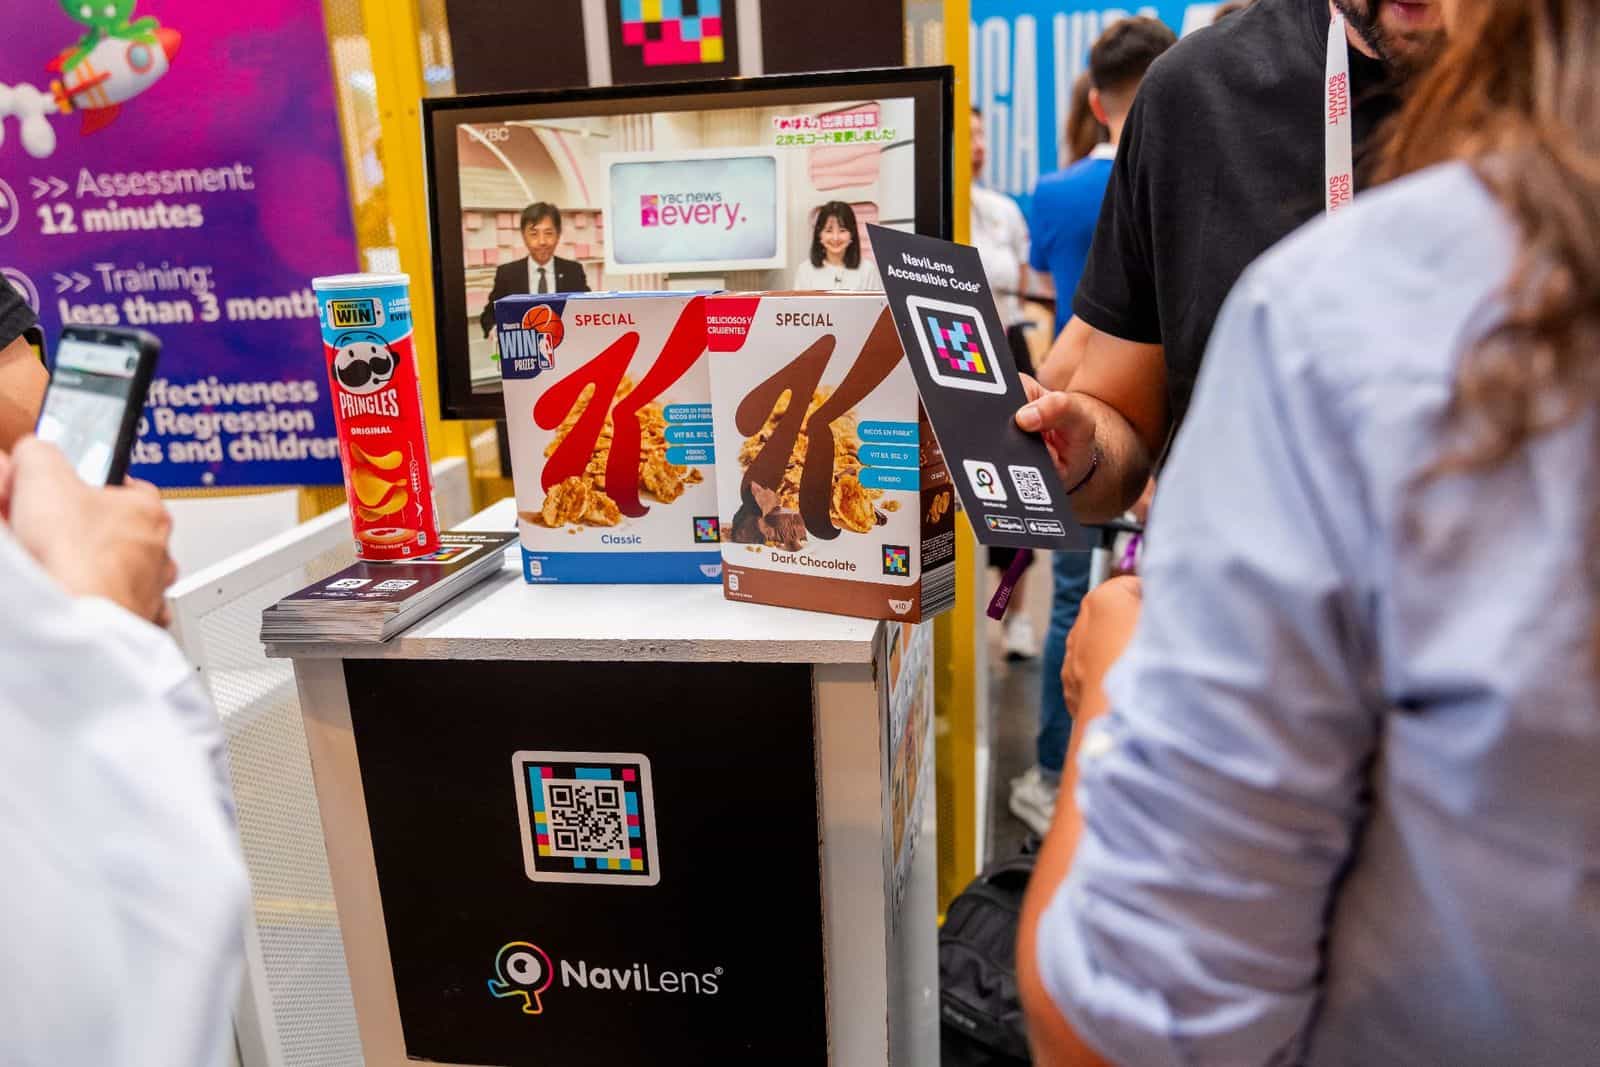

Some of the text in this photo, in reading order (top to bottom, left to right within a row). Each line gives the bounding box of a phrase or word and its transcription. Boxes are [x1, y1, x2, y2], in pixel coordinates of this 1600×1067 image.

[1337, 72, 1348, 116] SOUTH
[76, 162, 255, 198] Assessment:
[660, 192, 722, 204] YBC news
[37, 200, 204, 235] 12 minutes
[661, 203, 747, 231] every.
[888, 264, 949, 288] Accessible
[901, 252, 955, 274] NaviLens
[94, 262, 215, 297] Training:
[58, 298, 120, 325] less
[123, 294, 194, 325] than
[200, 290, 221, 322] 3
[336, 309, 371, 324] WIN
[575, 313, 636, 326] SPECIAL
[706, 316, 746, 325] DELICIOSOS
[776, 313, 834, 327] SPECIAL
[499, 329, 538, 360] WIN
[145, 375, 319, 407] ffectiveness
[338, 388, 400, 419] PRINGLES
[153, 403, 316, 441] Regression
[350, 425, 393, 435] ORIGINAL
[167, 436, 224, 463] and
[600, 534, 642, 545] Classic
[771, 552, 857, 572] Dark Chocolate
